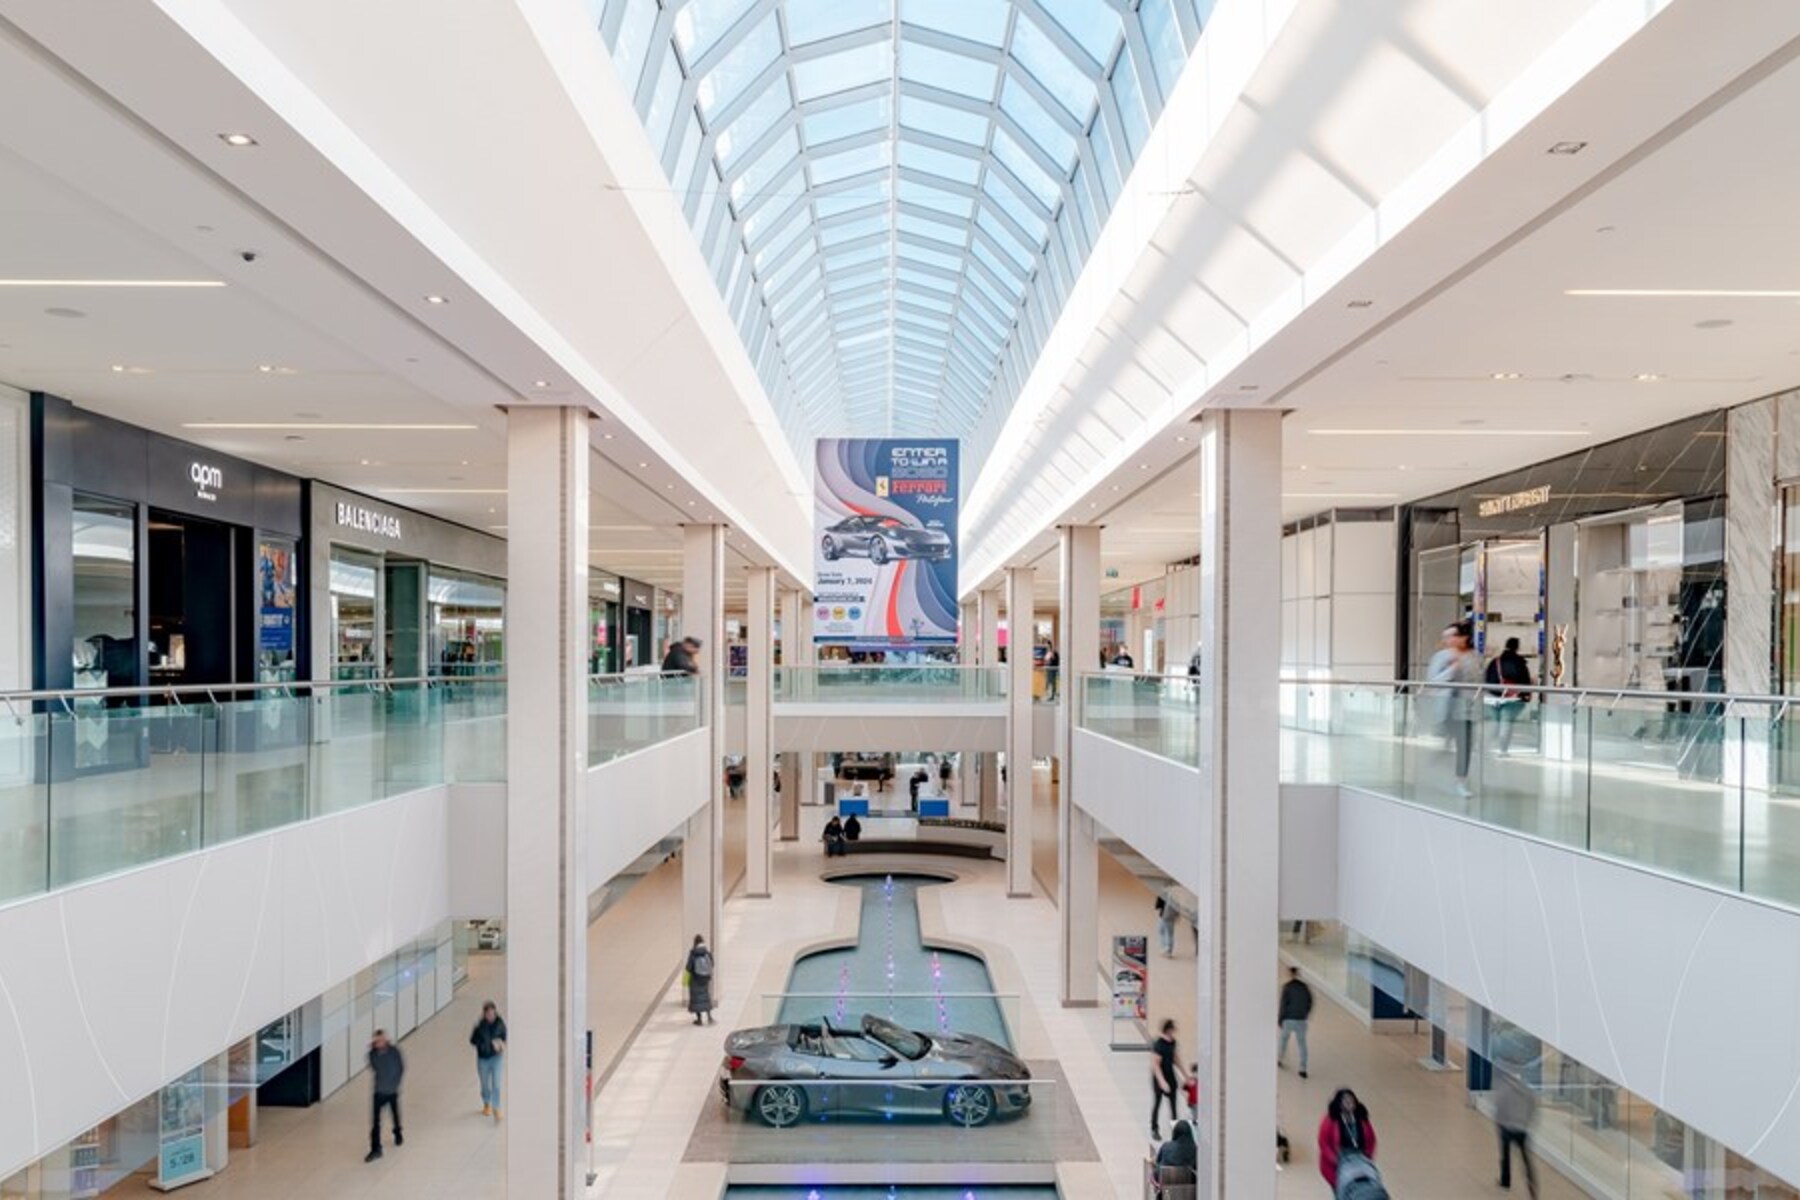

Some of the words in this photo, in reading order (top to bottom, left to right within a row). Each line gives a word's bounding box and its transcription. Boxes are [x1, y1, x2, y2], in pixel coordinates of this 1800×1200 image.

[891, 447, 947, 457] ENTER
[891, 457, 909, 466] TO
[911, 457, 936, 466] WIN
[892, 479, 947, 494] Ferrari
[338, 502, 401, 539] BALENCIAGA
[817, 577, 846, 587] January
